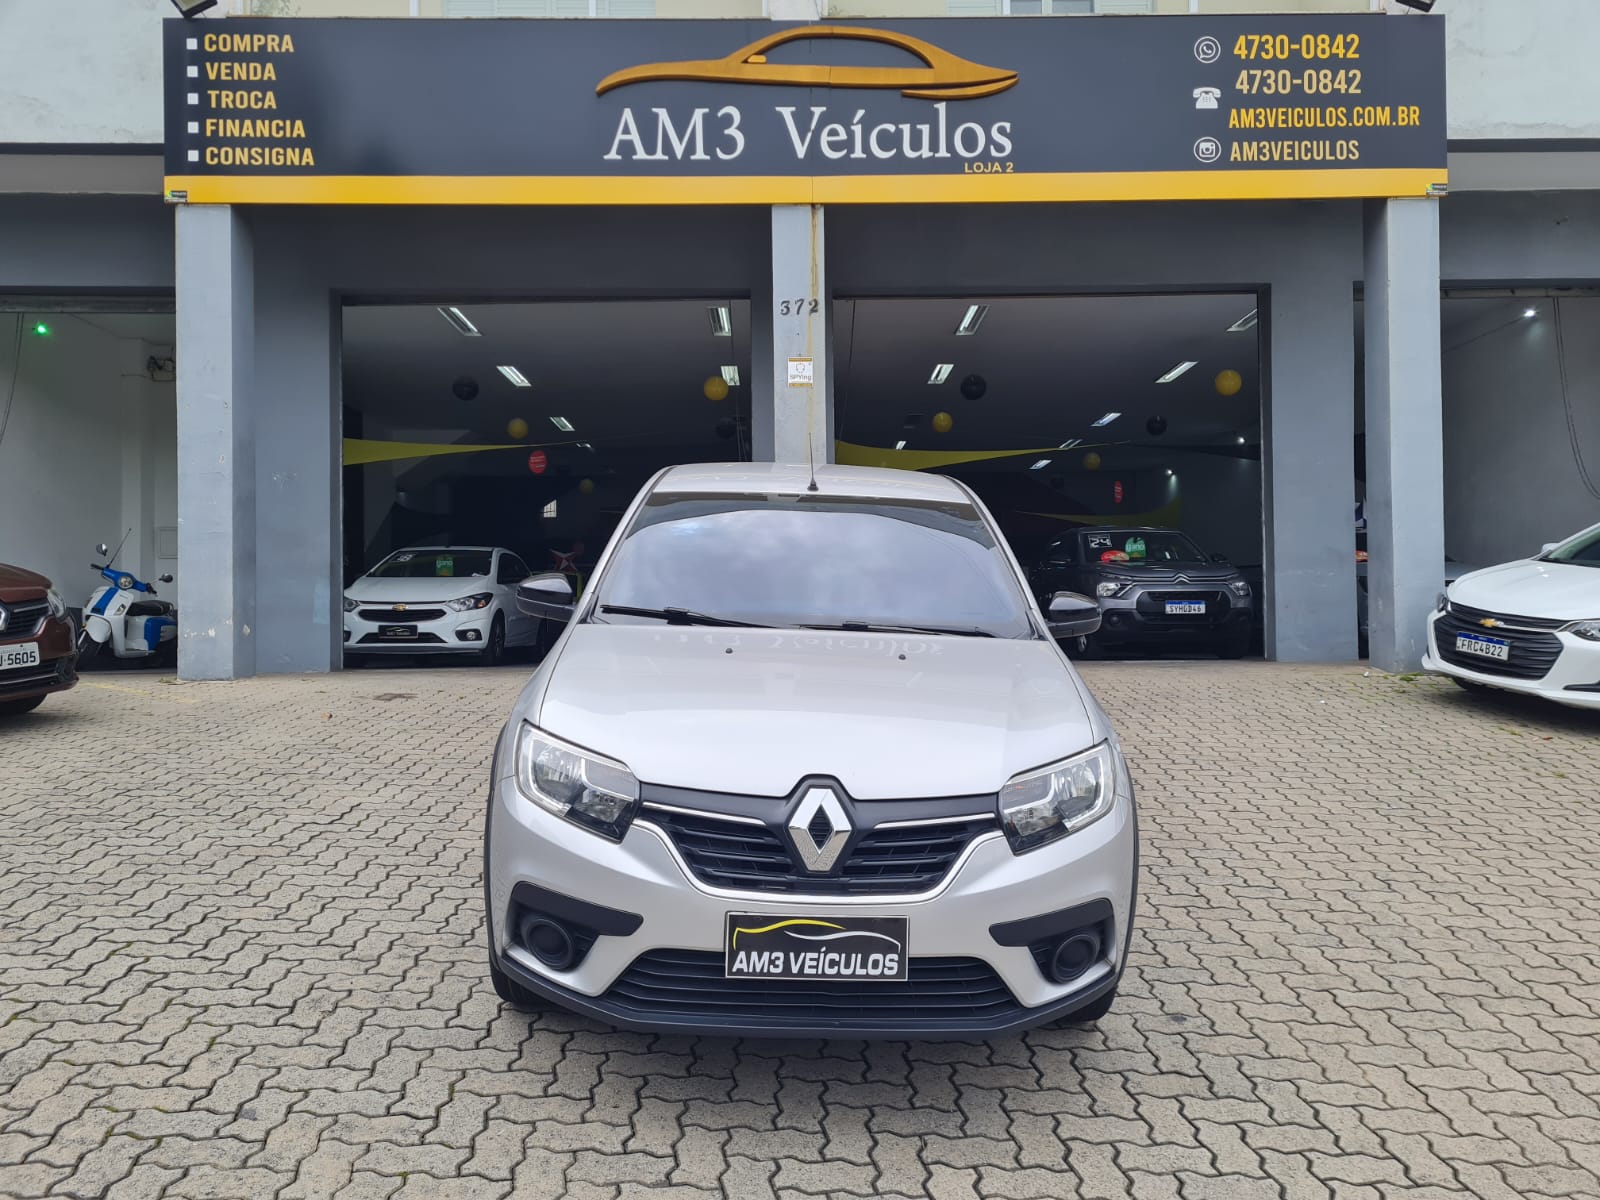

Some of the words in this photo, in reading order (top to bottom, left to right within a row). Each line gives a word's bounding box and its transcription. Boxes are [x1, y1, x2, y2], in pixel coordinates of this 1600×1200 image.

[203, 33, 295, 53] COMPRA
[1233, 34, 1360, 60] 4730-0842
[205, 62, 277, 81] VENDA
[1235, 69, 1362, 94] 4730-0842
[207, 90, 277, 109] TROCA
[1229, 105, 1420, 129] AM3VEICULOS.COM.BR
[205, 119, 306, 138] FINANCIA
[603, 105, 745, 161] AM3
[775, 101, 1013, 160] Veículos
[205, 147, 315, 166] CONSIGNA
[1230, 140, 1360, 162] AM3VEICULOS
[964, 161, 1001, 174] LOJA
[1002, 161, 1014, 173] 2
[780, 298, 819, 316] 372
[1461, 639, 1503, 656] FRC4B22
[732, 951, 785, 974] AM3
[789, 946, 899, 976] VEÍCULOS
